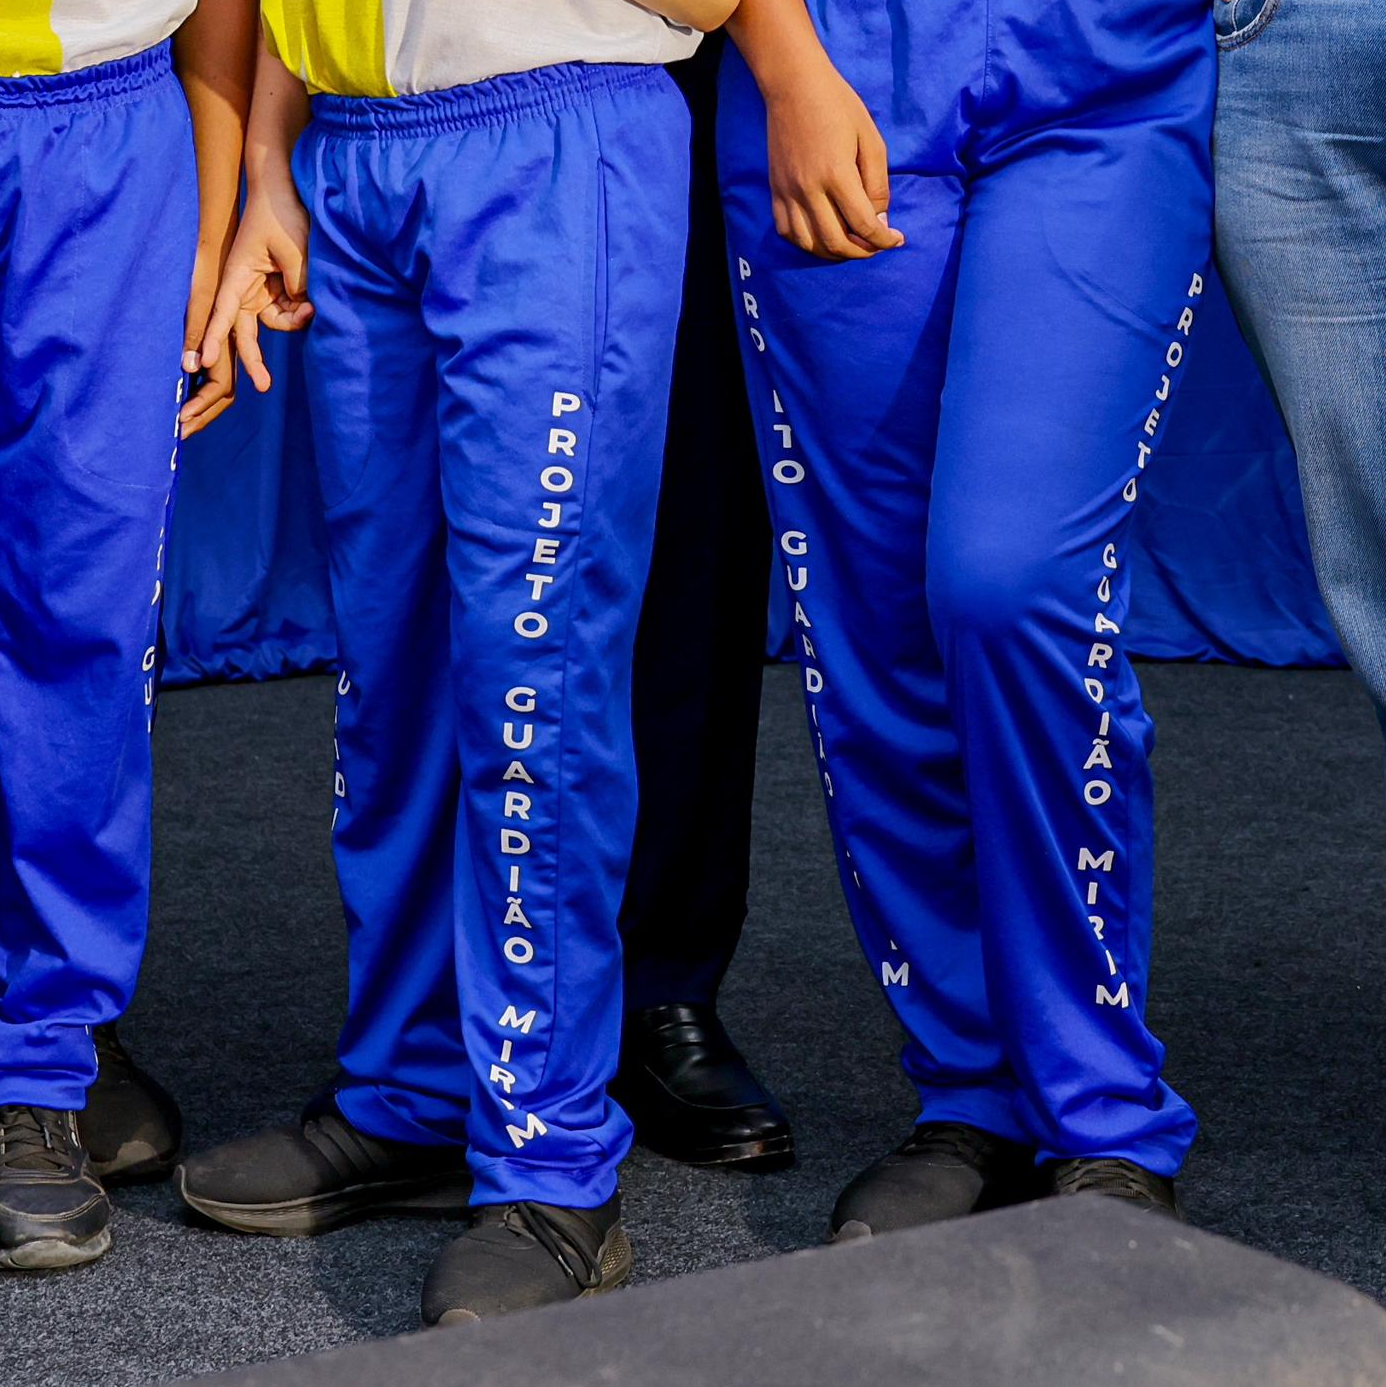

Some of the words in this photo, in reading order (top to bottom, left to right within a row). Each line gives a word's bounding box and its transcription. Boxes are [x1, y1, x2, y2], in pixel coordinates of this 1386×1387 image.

[1123, 272, 1203, 503] PROJETO
[513, 391, 581, 639] PROJETO
[1083, 543, 1121, 806] GUARDIÃO
[500, 686, 537, 965] GUARDIÃO
[1077, 846, 1129, 1009] MIRIM
[489, 1004, 549, 1149] MIRM
